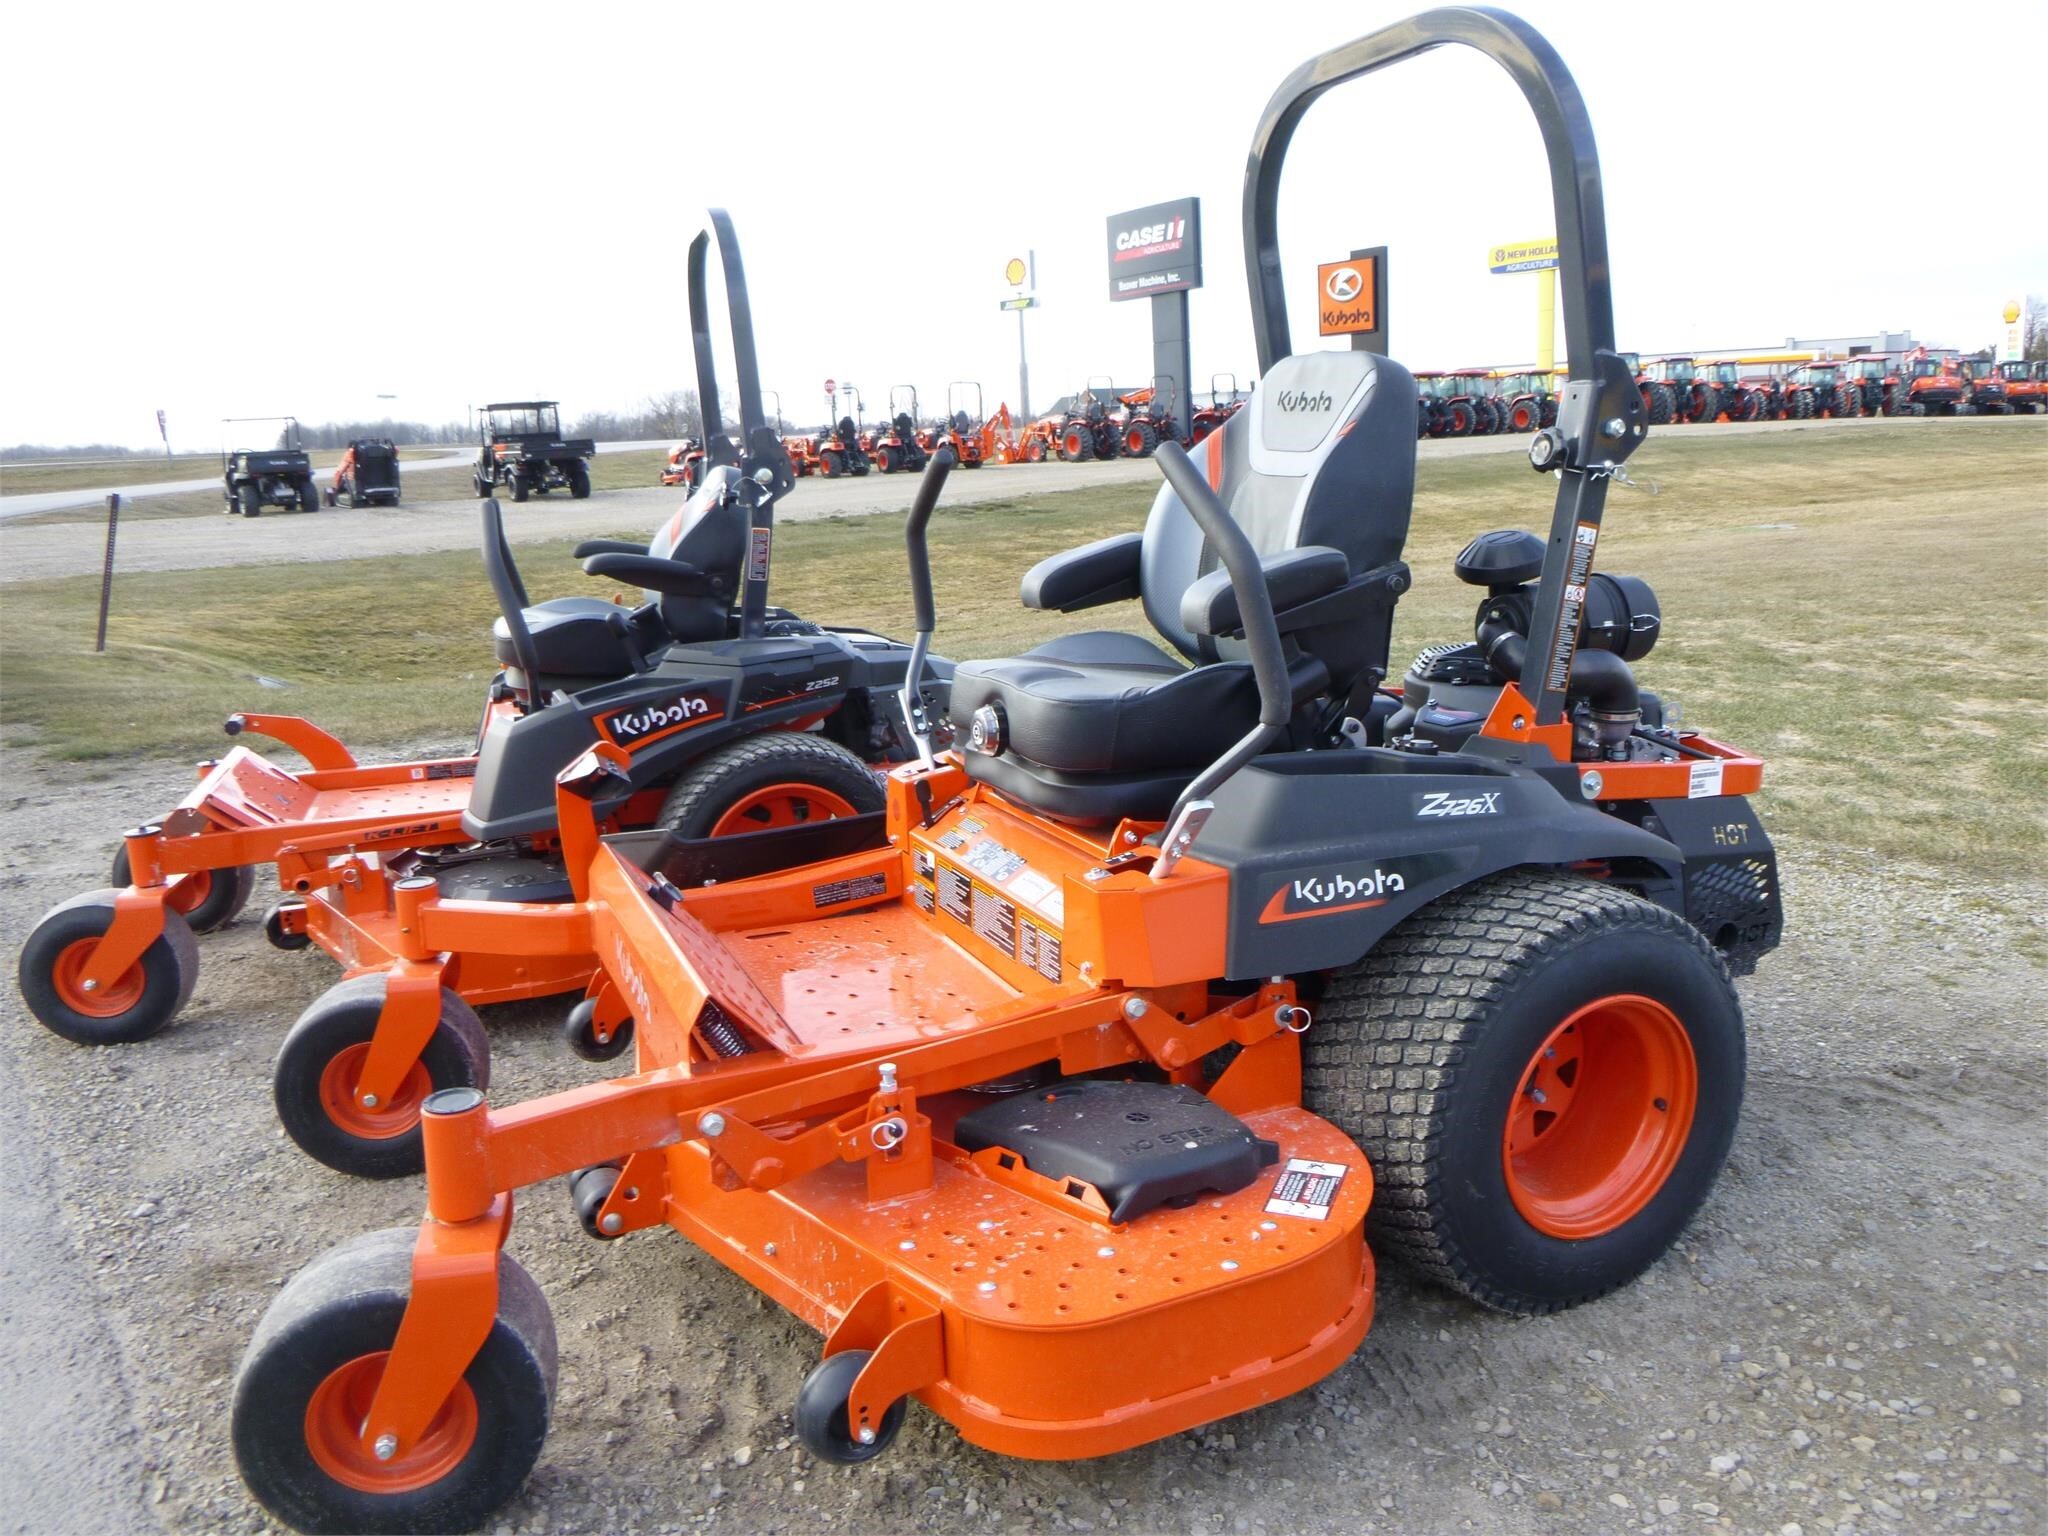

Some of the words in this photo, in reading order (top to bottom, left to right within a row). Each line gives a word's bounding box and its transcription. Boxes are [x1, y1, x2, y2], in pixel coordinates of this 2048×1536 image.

[1116, 224, 1166, 251] CASE
[1506, 259, 1553, 271] AGRICULTURE
[1507, 249, 1527, 259] NEW
[1323, 308, 1370, 326] Kubota
[1277, 390, 1332, 412] Kubota
[805, 676, 840, 692] Z252
[613, 696, 708, 735] Kubota
[1417, 792, 1501, 817] Z726X
[1712, 824, 1749, 846] HOT
[1294, 869, 1405, 904] Kubota
